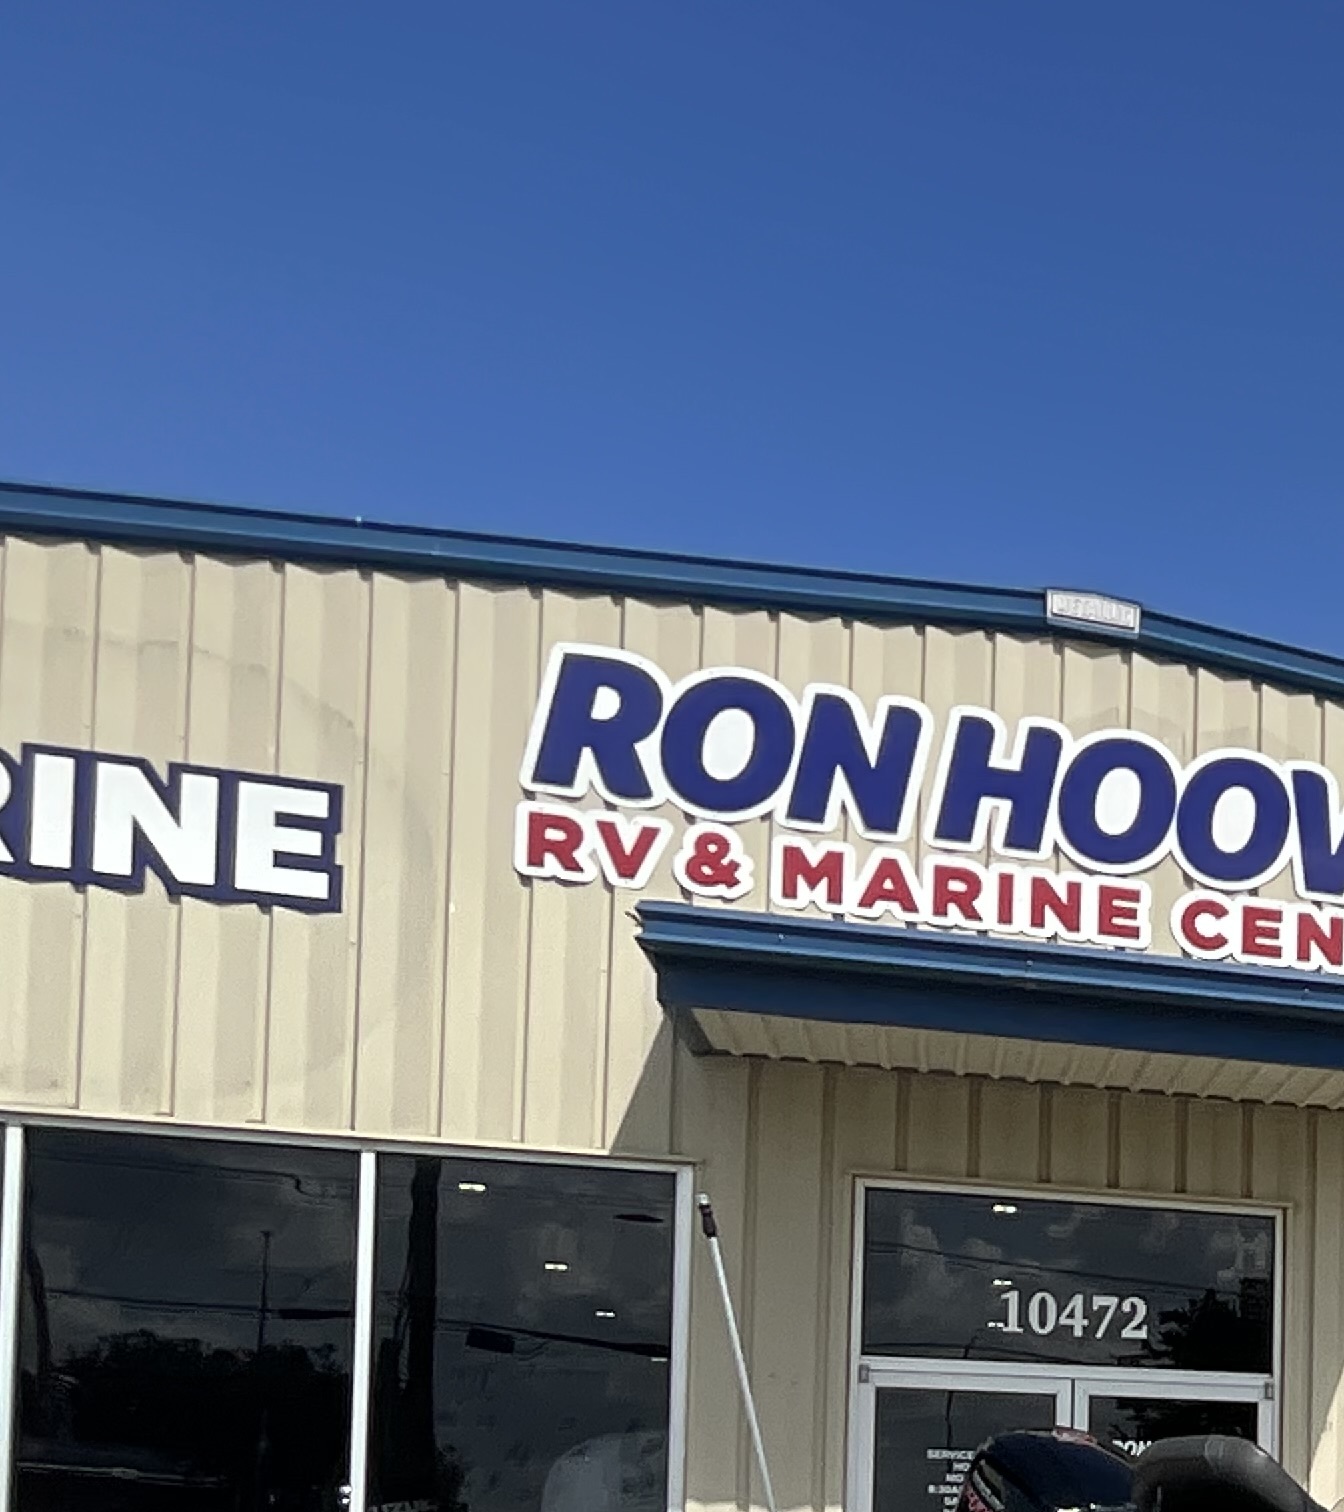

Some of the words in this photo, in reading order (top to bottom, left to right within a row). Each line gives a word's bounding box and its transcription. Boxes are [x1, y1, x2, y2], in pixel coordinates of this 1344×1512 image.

[530, 651, 923, 835] RON
[0, 750, 331, 901] INE
[526, 810, 662, 880] RV
[684, 831, 741, 890] &
[782, 844, 1143, 941] MARINE
[1000, 1290, 1147, 1340] 10472
